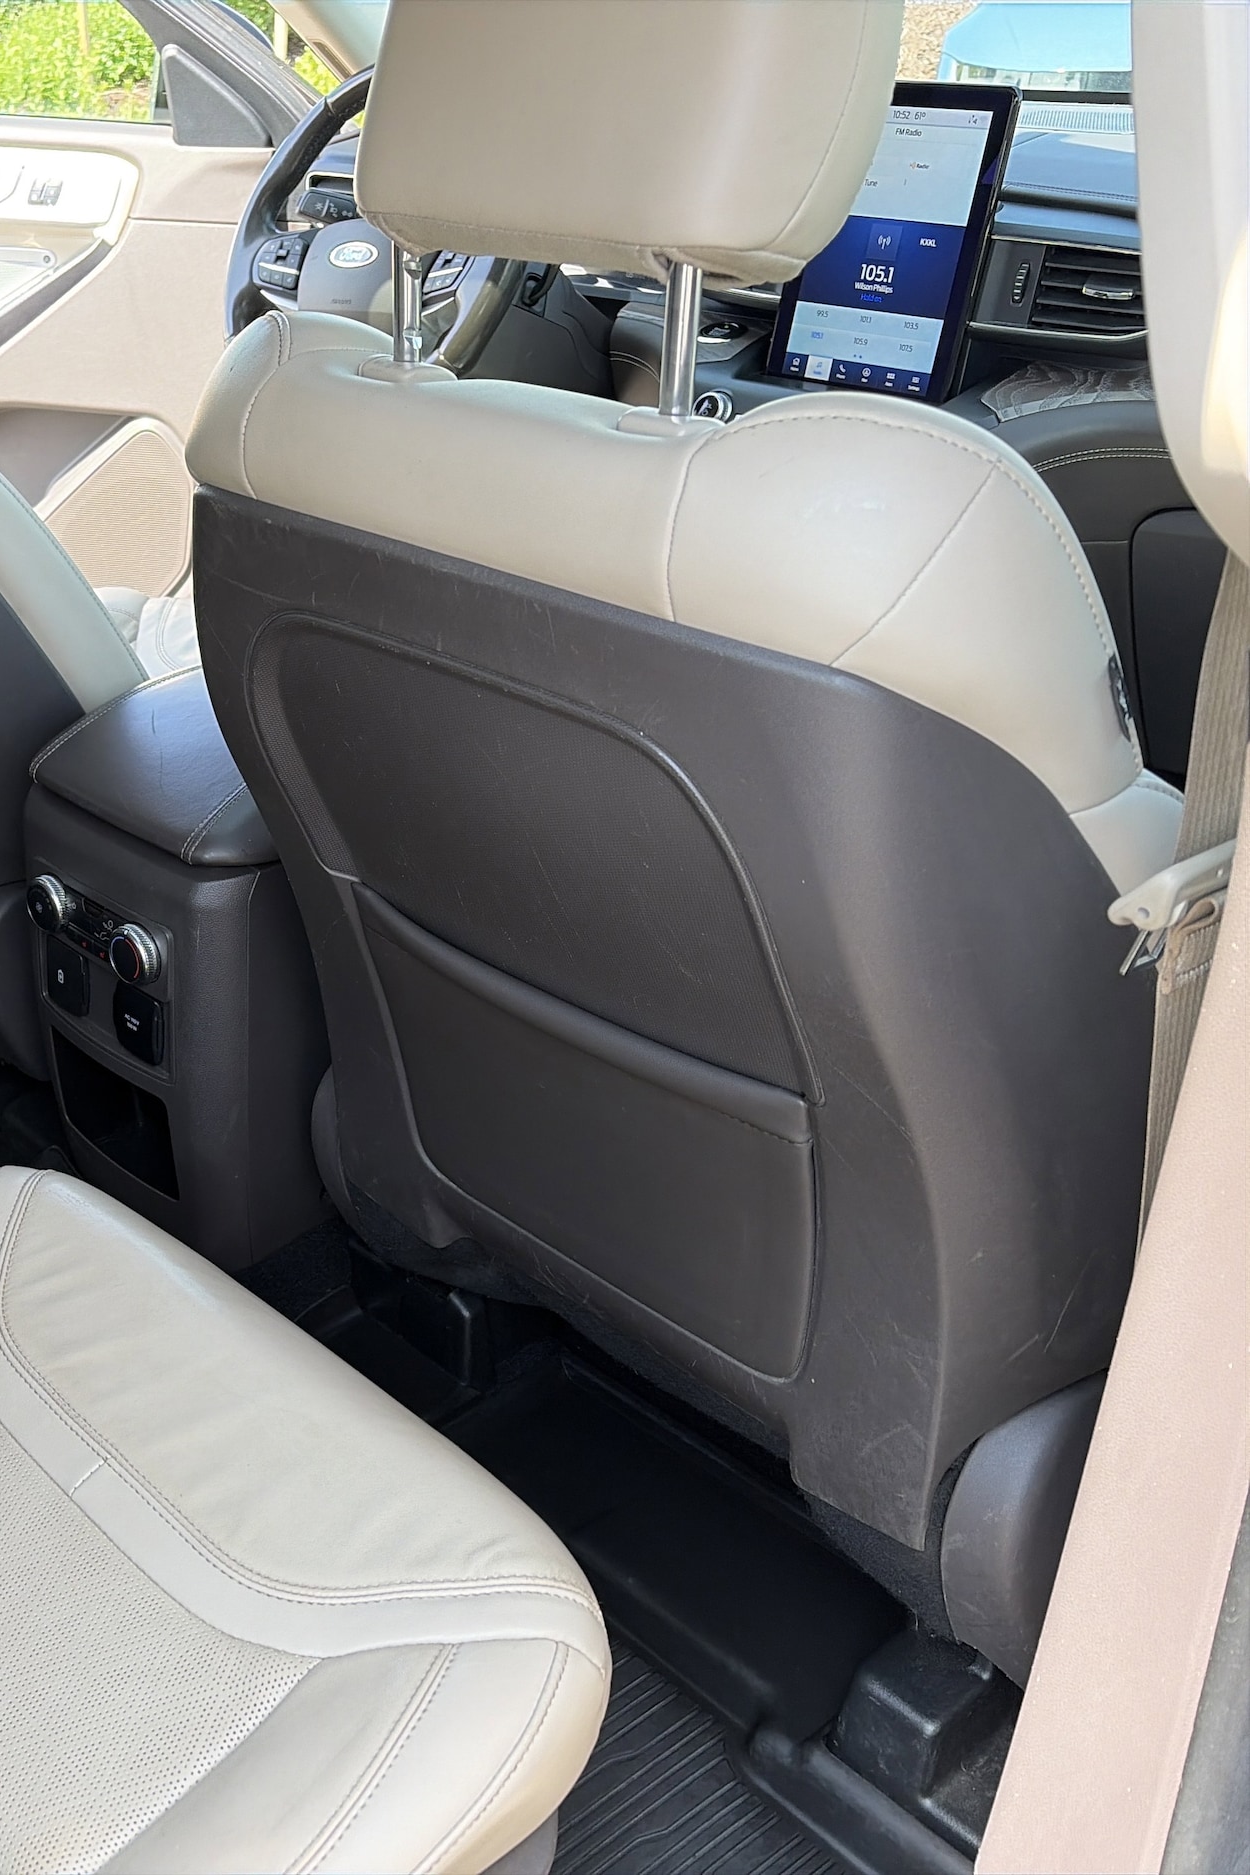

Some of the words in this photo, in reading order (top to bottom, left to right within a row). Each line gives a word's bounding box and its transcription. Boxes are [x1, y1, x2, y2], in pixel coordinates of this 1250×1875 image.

[892, 110, 911, 119] 10:52
[895, 128, 905, 136] FM
[905, 128, 922, 137] Radio
[864, 178, 878, 187] Tune
[860, 263, 895, 283] 105.1
[854, 281, 873, 291] Wilson
[873, 284, 894, 294] Phillips
[816, 309, 829, 318] 99.5
[903, 321, 919, 330] 103.5
[853, 337, 868, 346] 105.9
